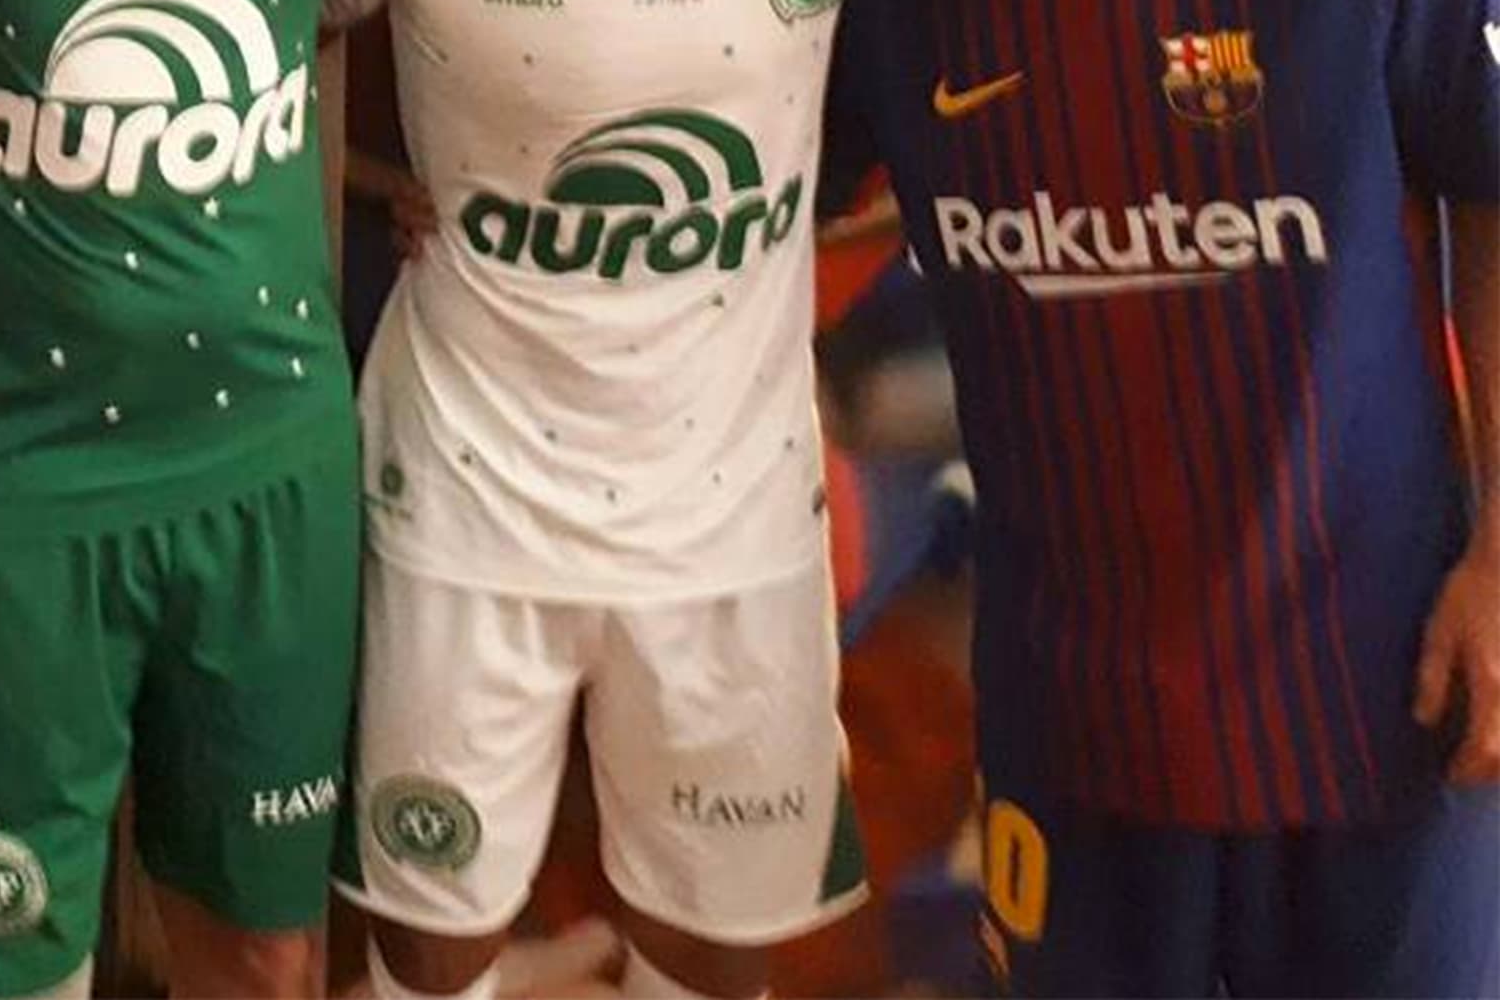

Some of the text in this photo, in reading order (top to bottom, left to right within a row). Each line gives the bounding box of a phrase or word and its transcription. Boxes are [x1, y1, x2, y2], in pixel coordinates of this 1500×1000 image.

[460, 170, 803, 280] aurora
[933, 190, 1329, 272] Rakuten
[252, 774, 339, 827] HAVA
[671, 778, 806, 831] HAVAN
